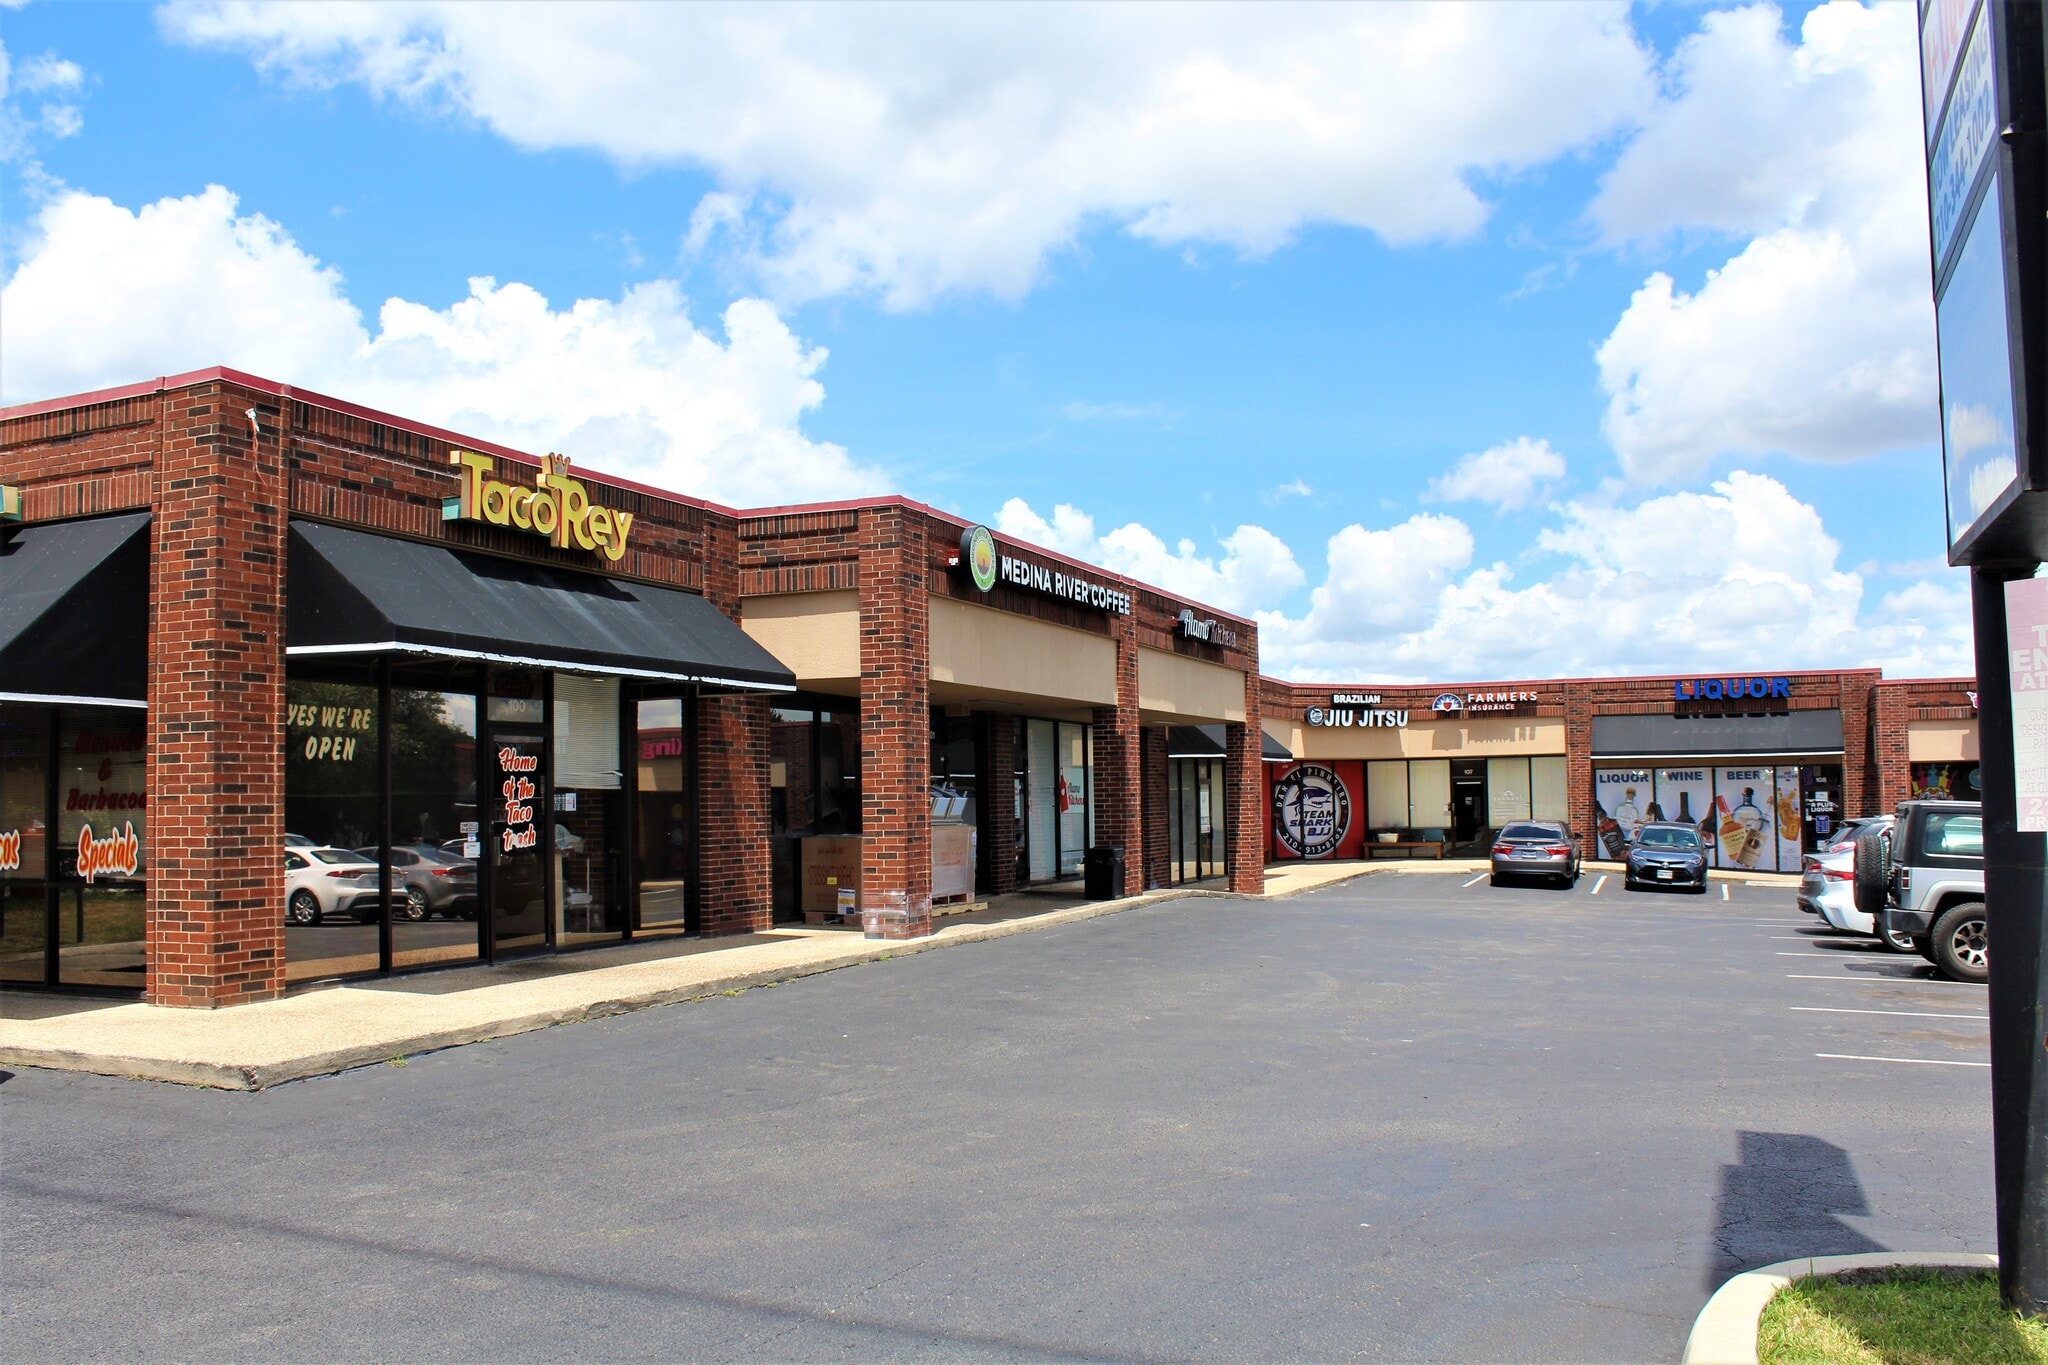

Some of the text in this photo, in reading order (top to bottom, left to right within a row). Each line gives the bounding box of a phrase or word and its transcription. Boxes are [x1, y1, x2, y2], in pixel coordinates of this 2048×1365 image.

[1949, 14, 1988, 154] LEASING
[1936, 80, 1991, 251] 210-344-1002
[1001, 555, 1052, 593] MEDINA
[1054, 572, 1089, 603] RIVER
[1090, 584, 1131, 616] COFFEE
[1467, 691, 1538, 703] FARMERS
[1674, 677, 1790, 700] LIQUOR
[507, 699, 526, 712] 100
[1333, 694, 1381, 704] BRAZILIAN
[1468, 703, 1515, 711] INSURANCE
[286, 703, 372, 730] YES WE'RE
[1324, 709, 1408, 727] JIU JITSU
[304, 735, 356, 761] OPEN
[499, 747, 537, 772] Home
[1599, 773, 1649, 783] LIQUOR
[1667, 771, 1703, 781] WINE
[1726, 770, 1761, 780] BEER
[503, 775, 535, 801] of the
[505, 800, 533, 825] Taco
[1303, 810, 1334, 818] TEAM
[1307, 827, 1332, 836] BJJ
[77, 820, 138, 884] Specials
